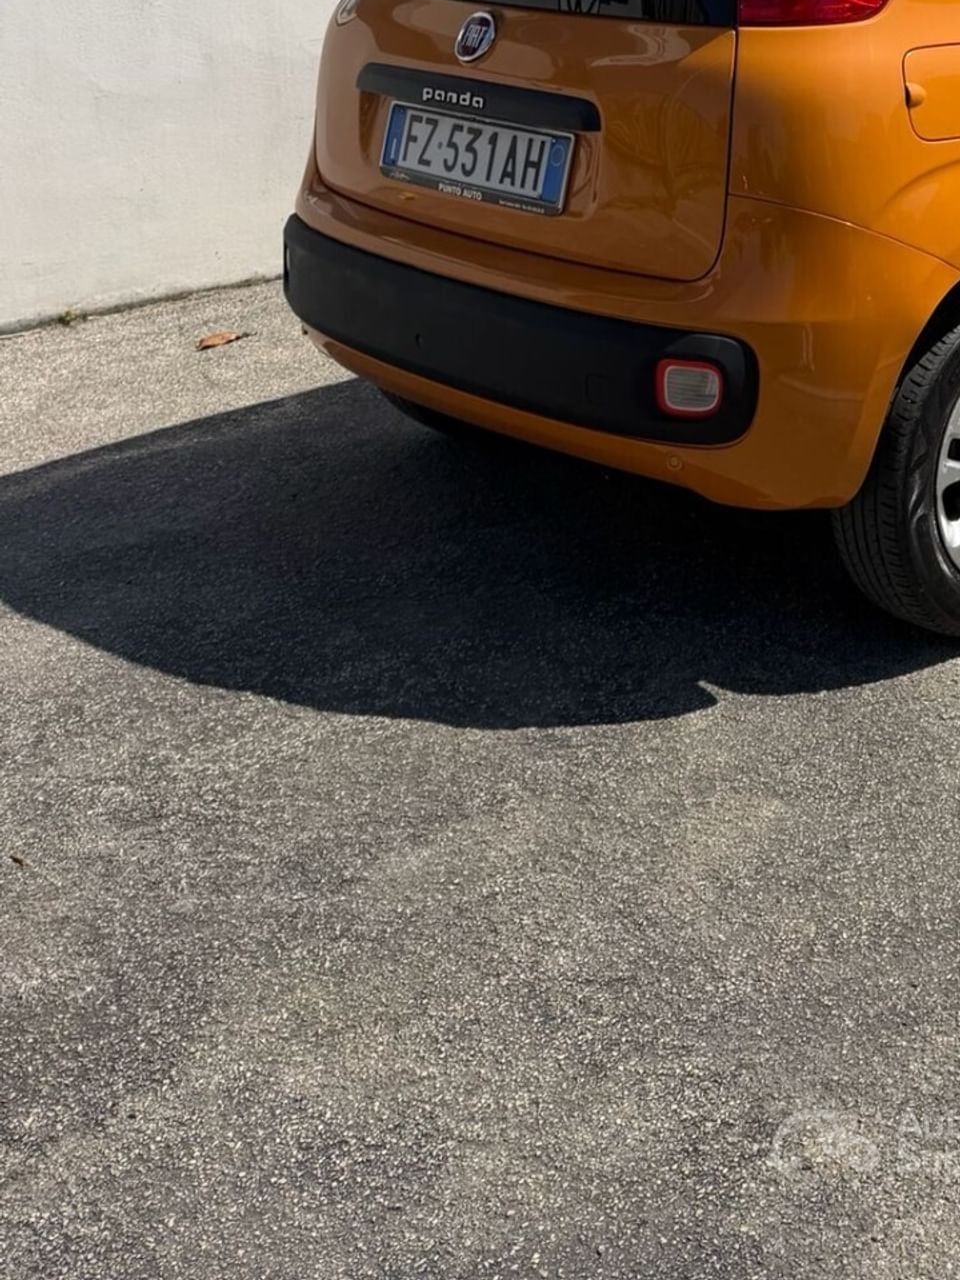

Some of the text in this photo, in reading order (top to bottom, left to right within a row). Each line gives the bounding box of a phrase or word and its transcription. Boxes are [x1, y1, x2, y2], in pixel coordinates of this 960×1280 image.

[462, 23, 489, 49] FIAT
[422, 87, 484, 109] panda
[438, 182, 483, 201] PUNTO AUTO
